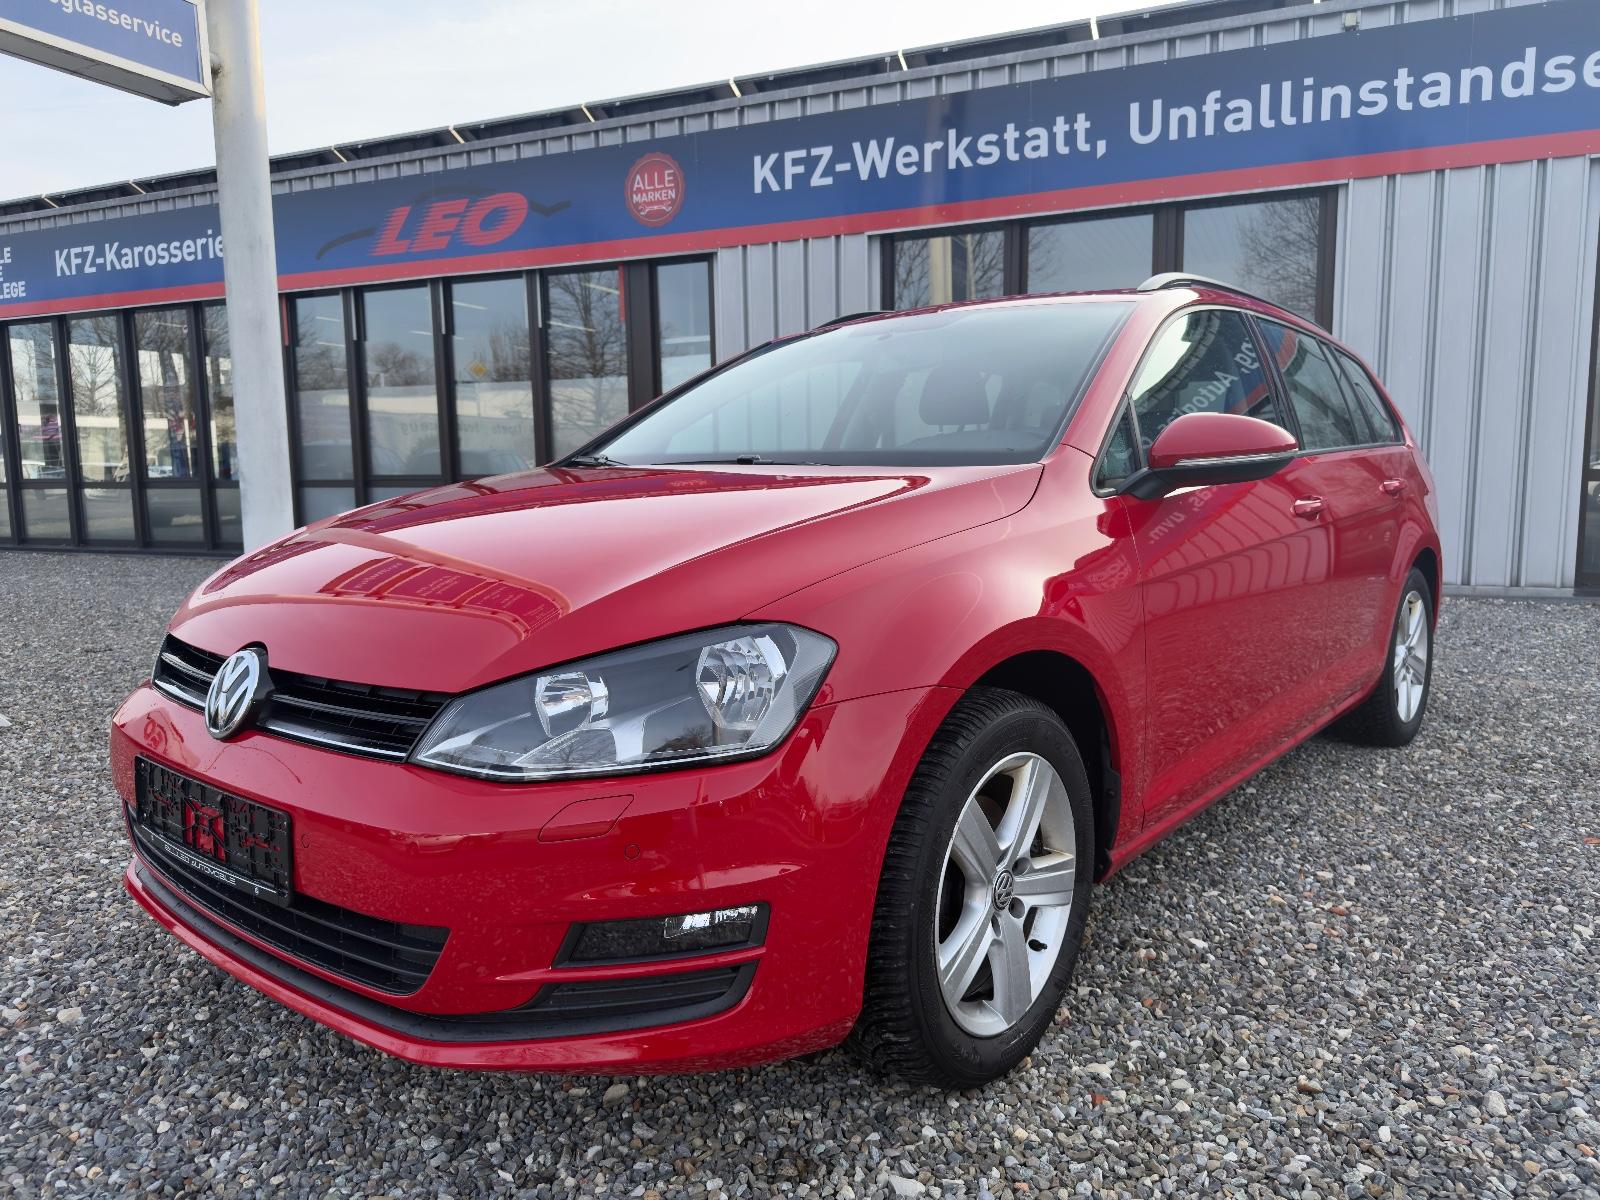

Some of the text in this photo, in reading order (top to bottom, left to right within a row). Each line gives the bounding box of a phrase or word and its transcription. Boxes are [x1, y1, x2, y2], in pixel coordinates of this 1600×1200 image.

[49, 0, 183, 47] glasservice
[753, 112, 1107, 194] KFZ-Werkstatt,
[632, 189, 676, 204] MARKEN
[633, 170, 675, 191] ALLE
[365, 191, 529, 256] LEO
[55, 229, 223, 277] KFZ-Karosserie
